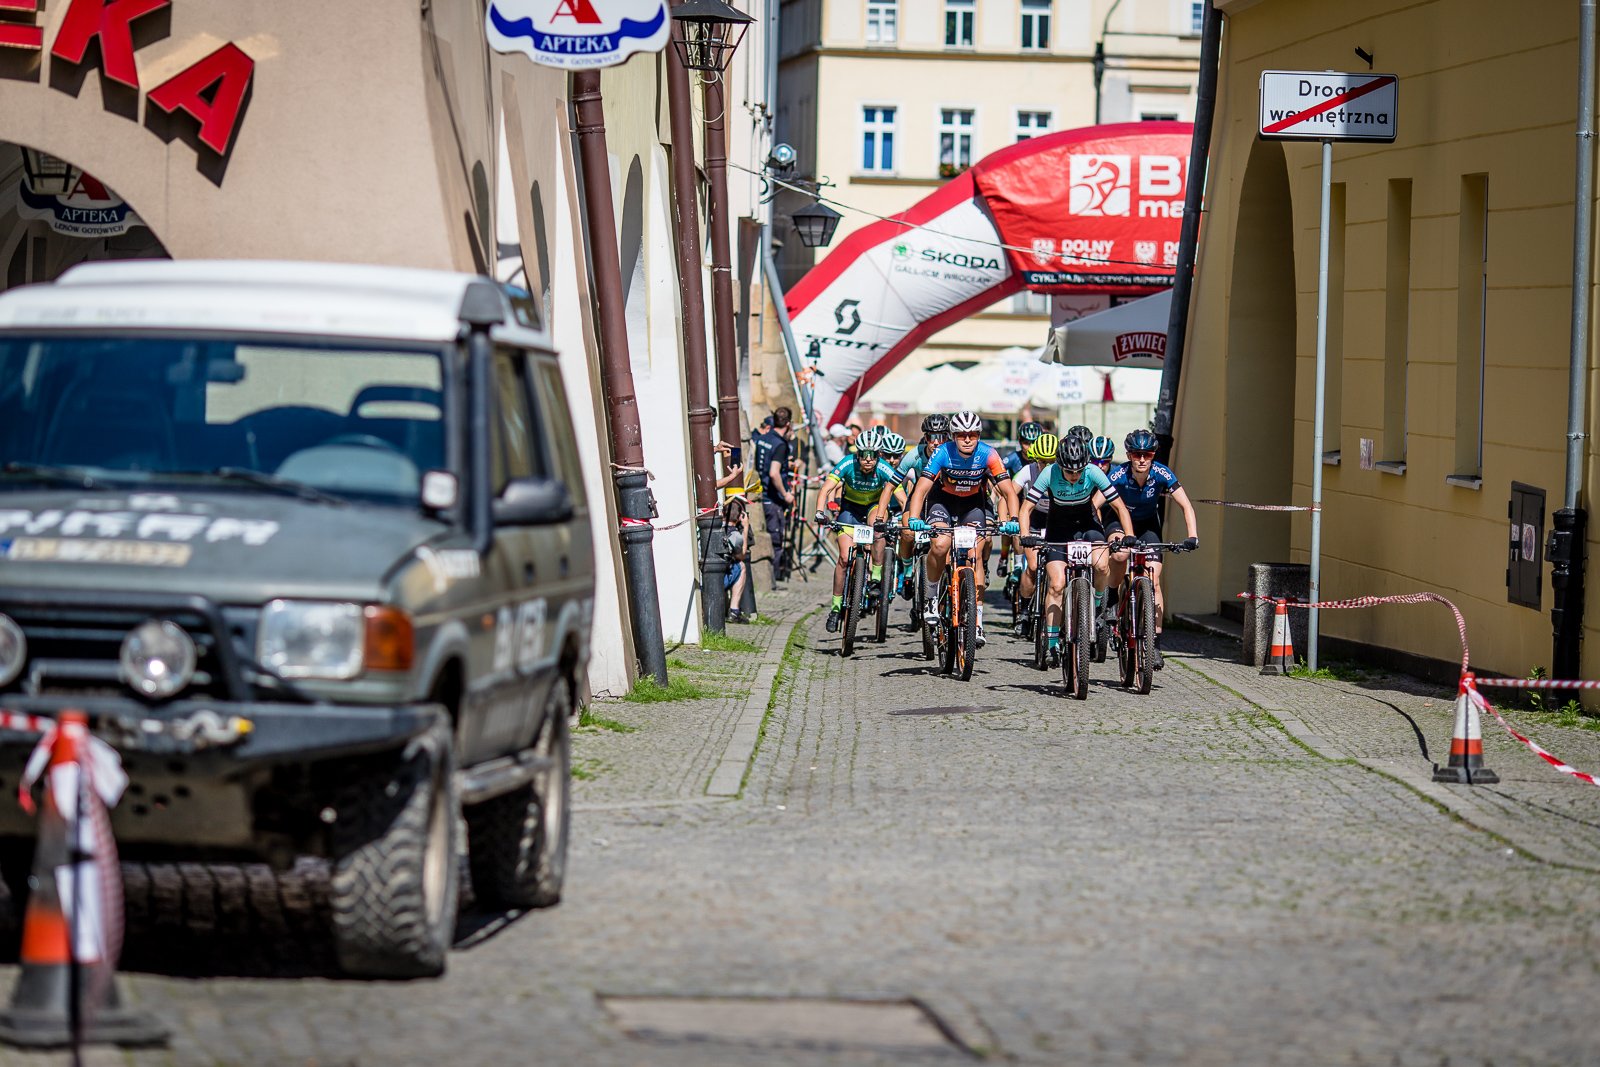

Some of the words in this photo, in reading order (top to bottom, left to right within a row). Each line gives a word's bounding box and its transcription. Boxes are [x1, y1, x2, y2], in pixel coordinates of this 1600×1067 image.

[540, 35, 613, 53] APTEKA
[1139, 155, 1192, 196] B
[61, 208, 119, 222] APTEKA
[1061, 239, 1114, 253] DOLNY
[1120, 334, 1166, 352] ŻYWIEC
[856, 528, 871, 540] 209
[1071, 545, 1088, 560] 203
